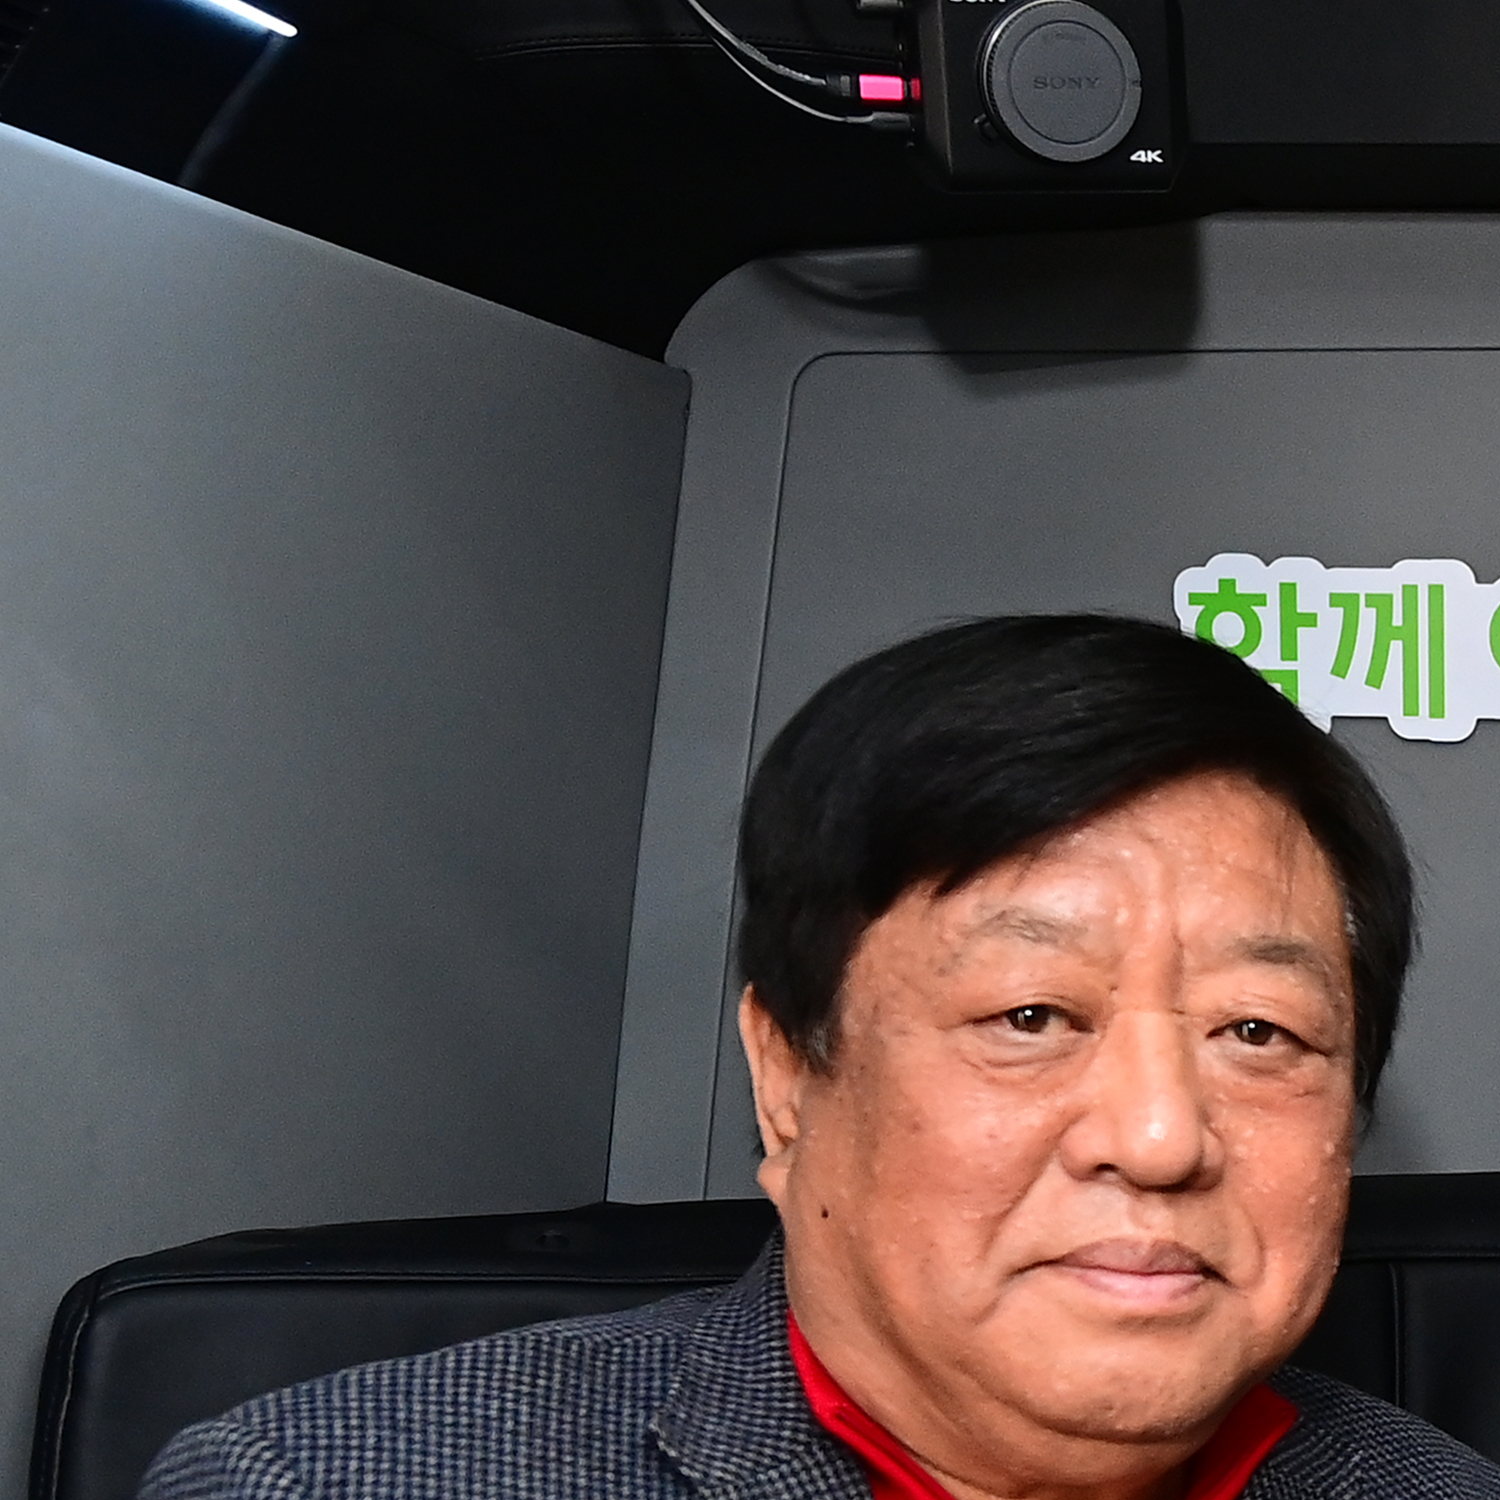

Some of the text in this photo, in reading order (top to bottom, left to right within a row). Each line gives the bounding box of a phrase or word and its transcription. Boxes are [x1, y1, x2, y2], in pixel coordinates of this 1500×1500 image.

[1032, 75, 1101, 91] SONY
[1129, 149, 1164, 163] 4K
[1188, 578, 1446, 719] 함께
